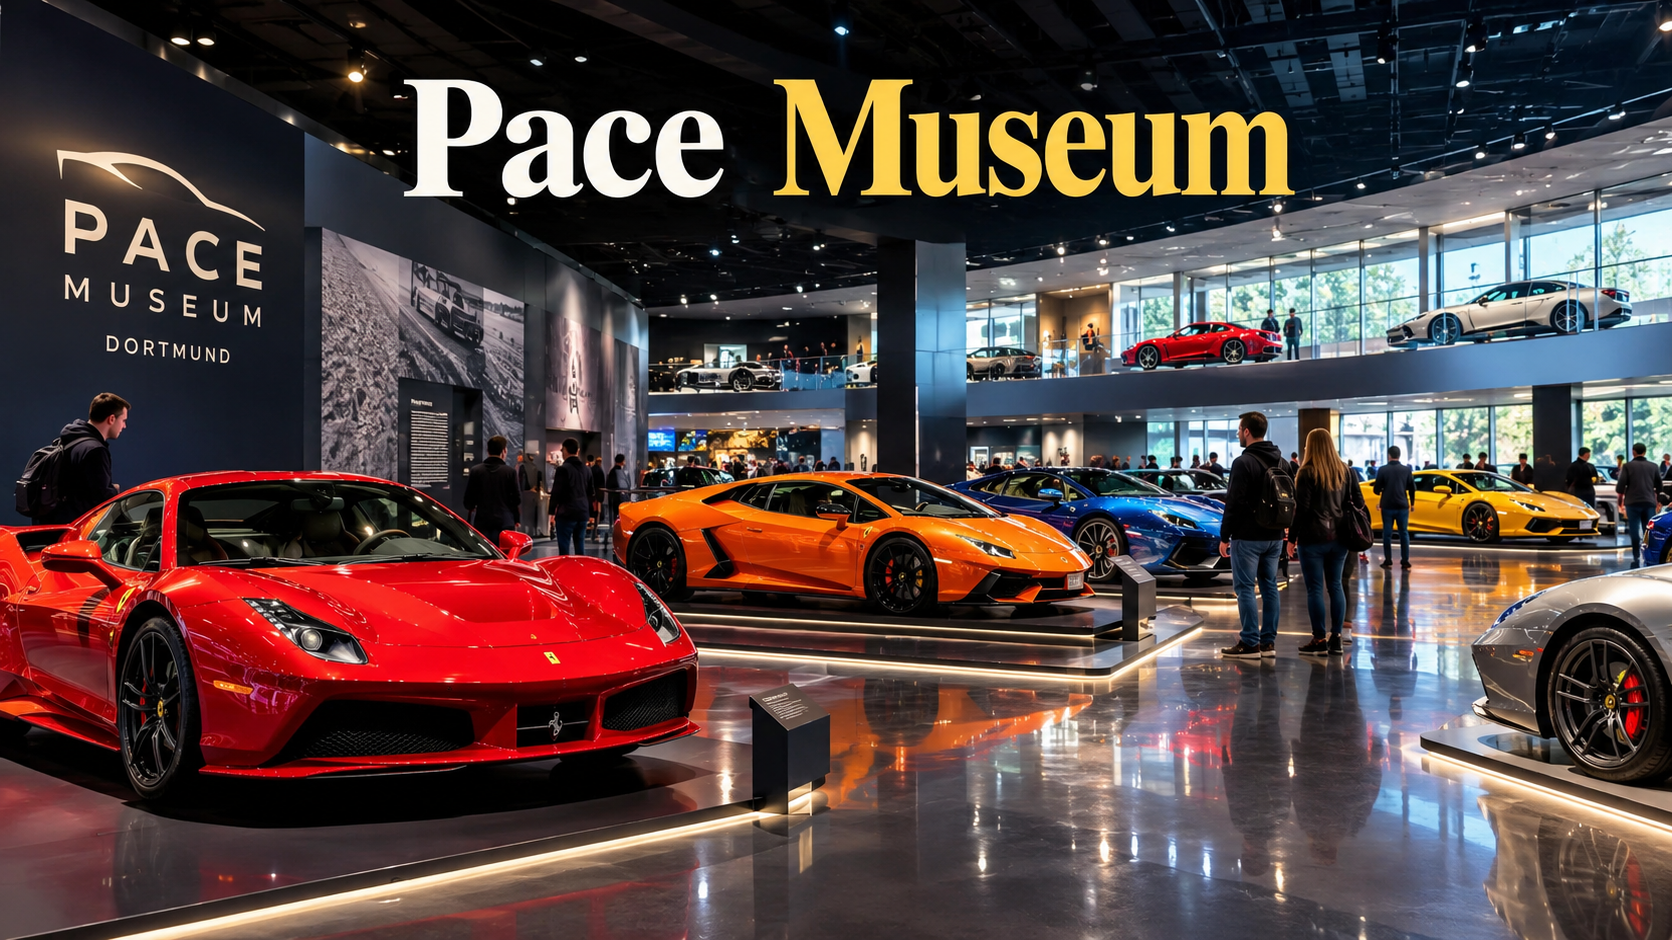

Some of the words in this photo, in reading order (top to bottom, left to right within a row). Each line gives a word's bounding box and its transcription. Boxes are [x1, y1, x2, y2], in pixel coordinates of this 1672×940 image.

[64, 198, 263, 290] PACE
[64, 274, 262, 328] MUSEUM
[105, 334, 231, 364] DORTMUND
